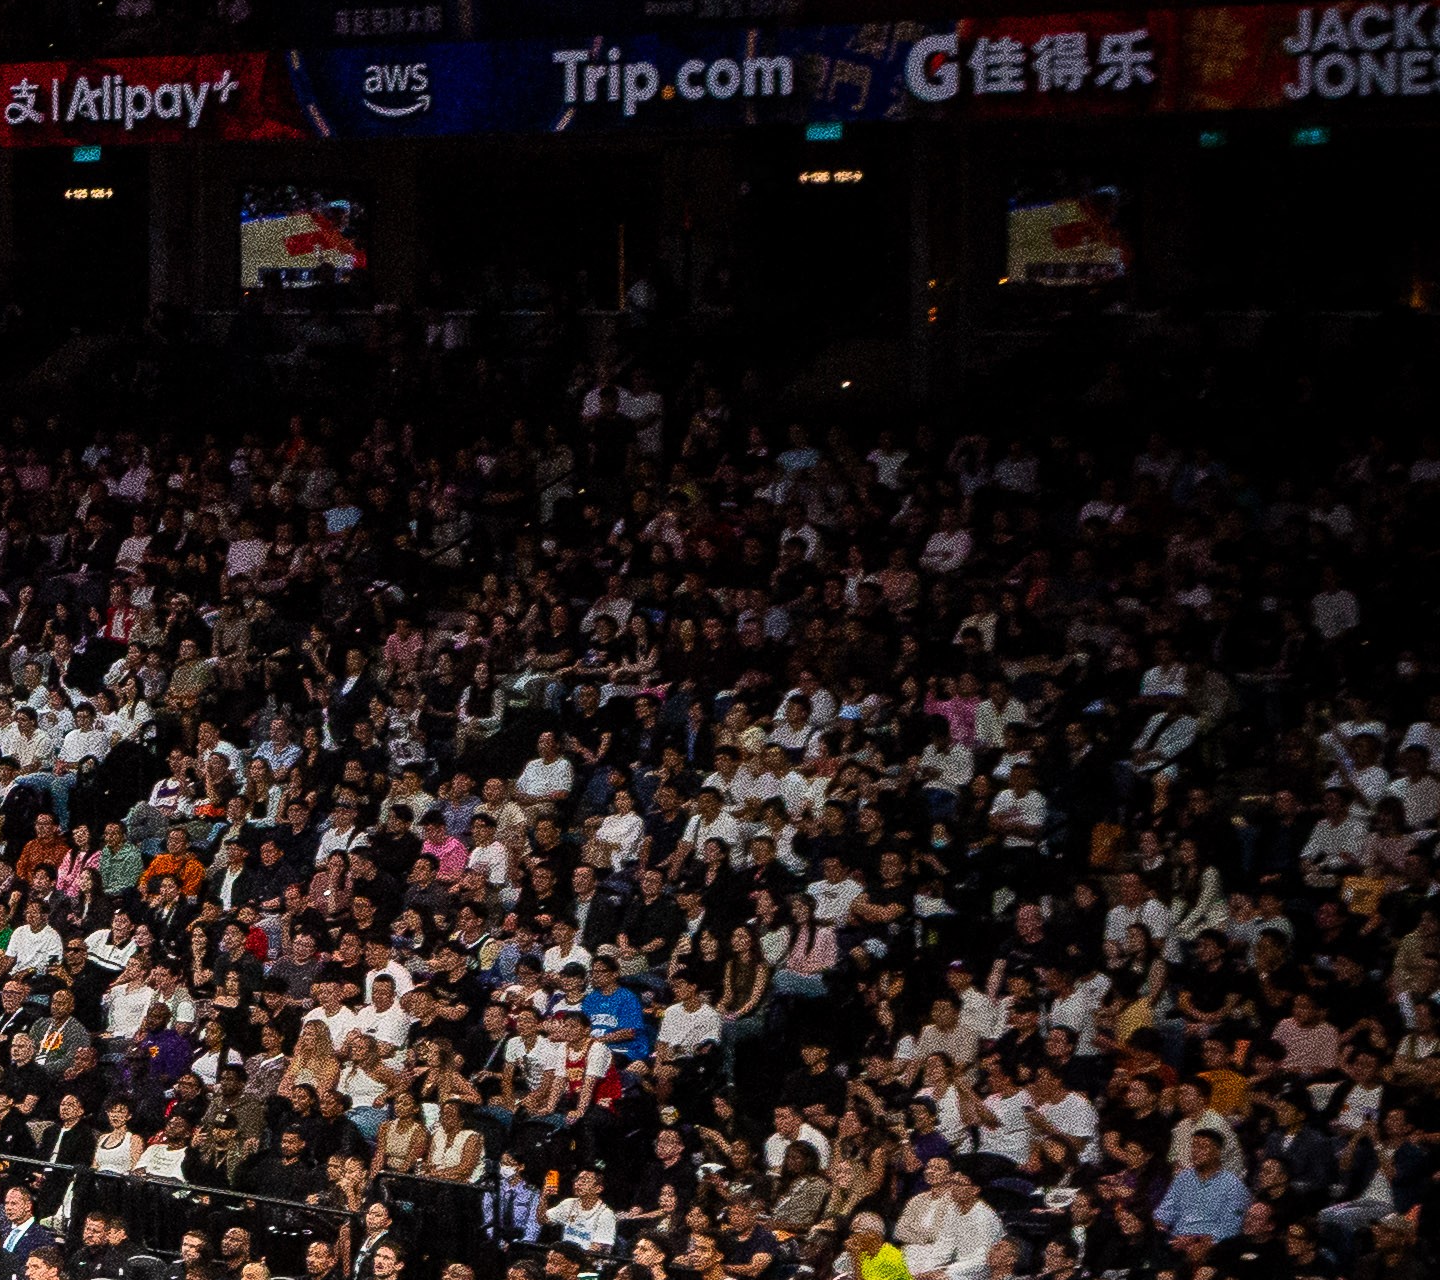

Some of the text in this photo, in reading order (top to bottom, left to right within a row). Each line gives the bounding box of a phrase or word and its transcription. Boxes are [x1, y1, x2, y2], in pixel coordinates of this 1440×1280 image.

[1283, 2, 1425, 53] JACK
[363, 61, 428, 95] aws
[553, 47, 793, 116] Trip.com
[968, 28, 1155, 95] 佳得乐
[1283, 50, 1440, 102] JONE
